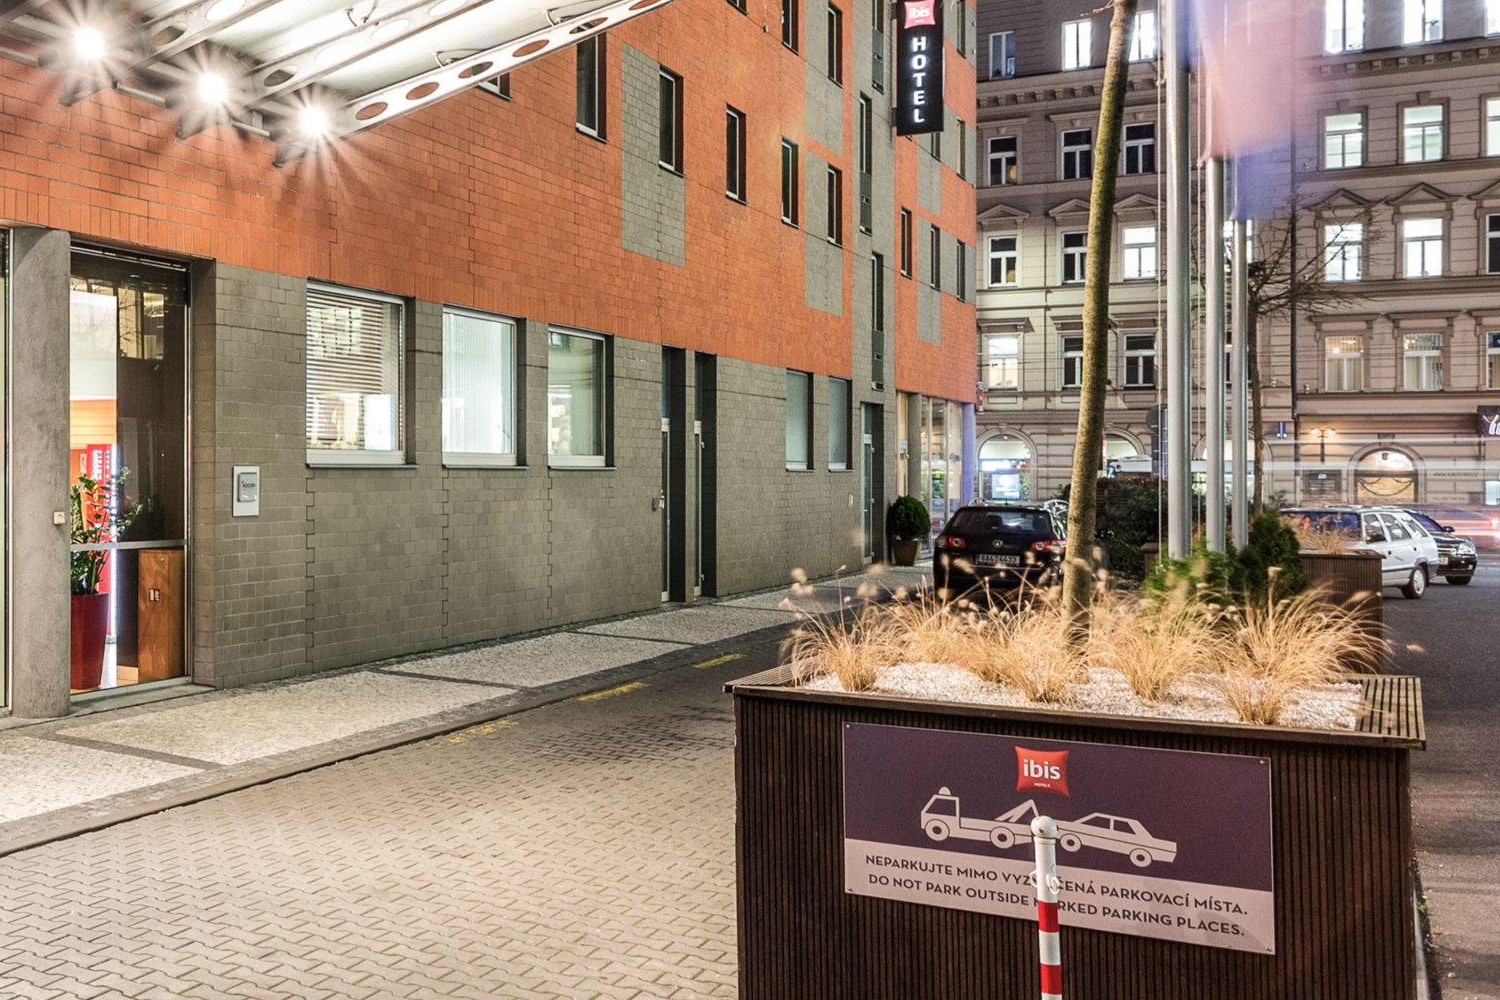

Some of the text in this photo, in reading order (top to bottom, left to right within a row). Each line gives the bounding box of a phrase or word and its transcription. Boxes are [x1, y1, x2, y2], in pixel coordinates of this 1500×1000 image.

[908, 6, 931, 19] ibis
[911, 35, 927, 123] HOTEL
[1023, 759, 1061, 780] ibis
[865, 854, 1248, 915] NEPARKUJTE MIMO VYZČENÁ PARKOVACÍ MÍSTA.
[868, 873, 1245, 936] DO NOT PARK OUTSIDE RKED PARKING PLACES.
